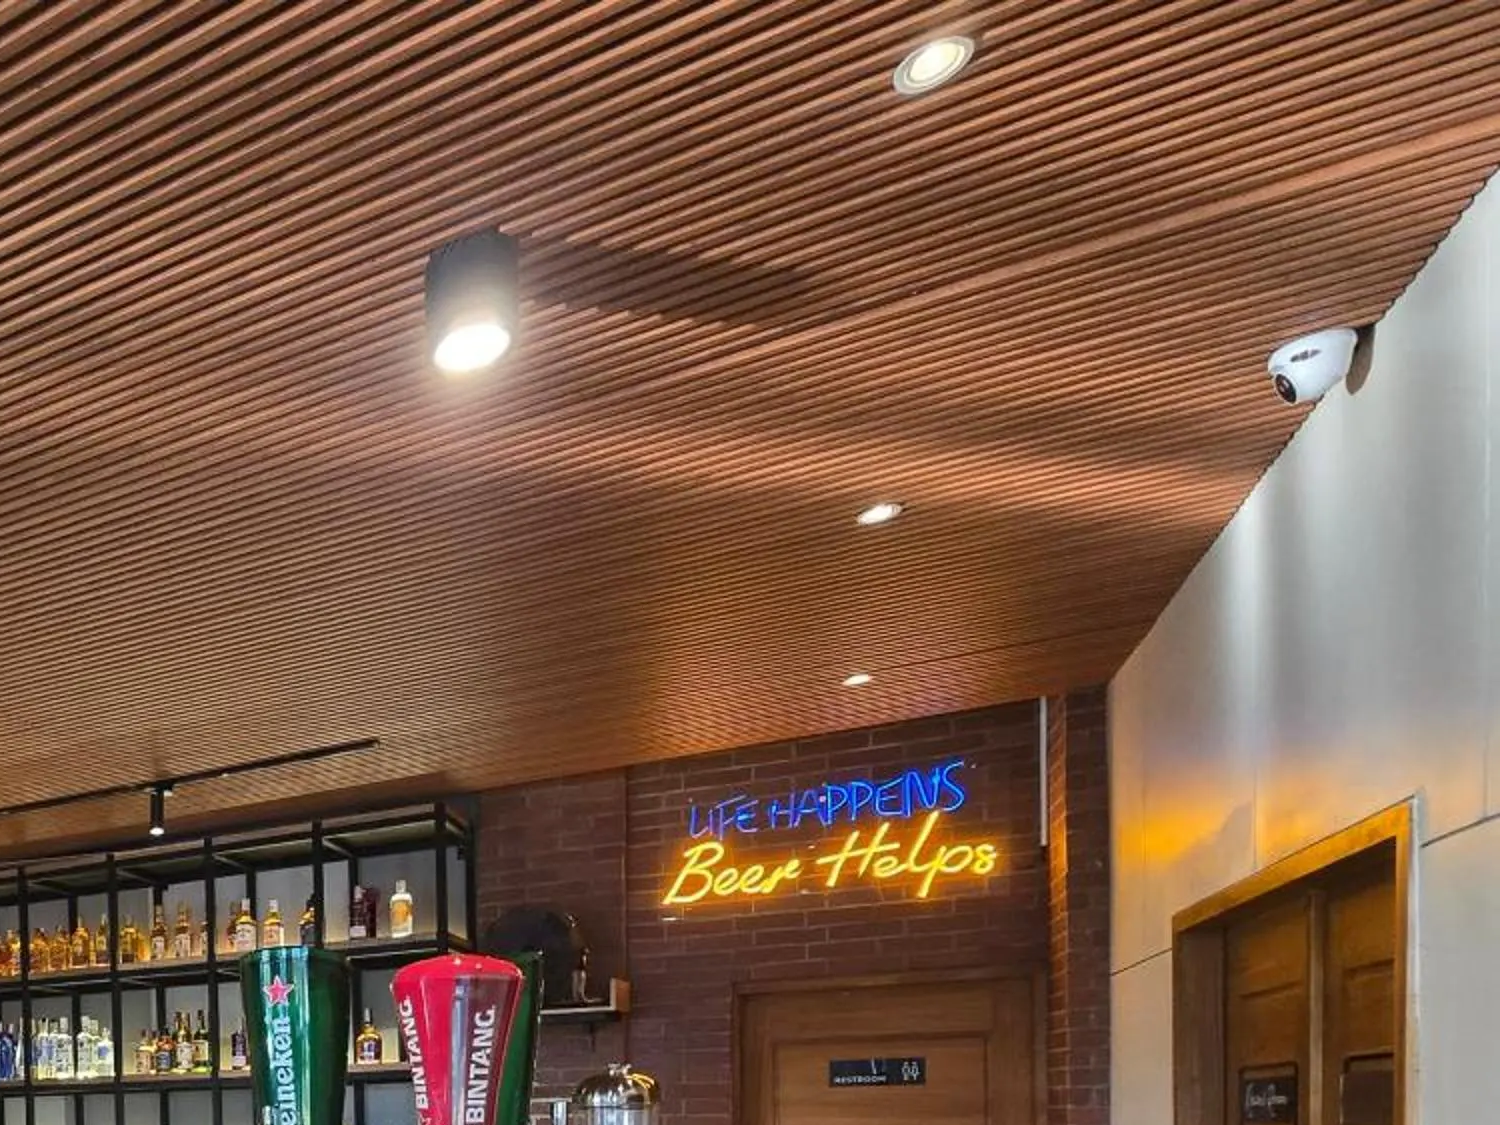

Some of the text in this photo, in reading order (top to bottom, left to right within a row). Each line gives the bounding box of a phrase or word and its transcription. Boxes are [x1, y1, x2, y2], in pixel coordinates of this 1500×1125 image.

[688, 759, 965, 841] LIFE HAPPENS
[662, 810, 998, 905] Beer Helps
[400, 995, 429, 1109] BINTANG
[466, 1005, 497, 1124] BINTANG
